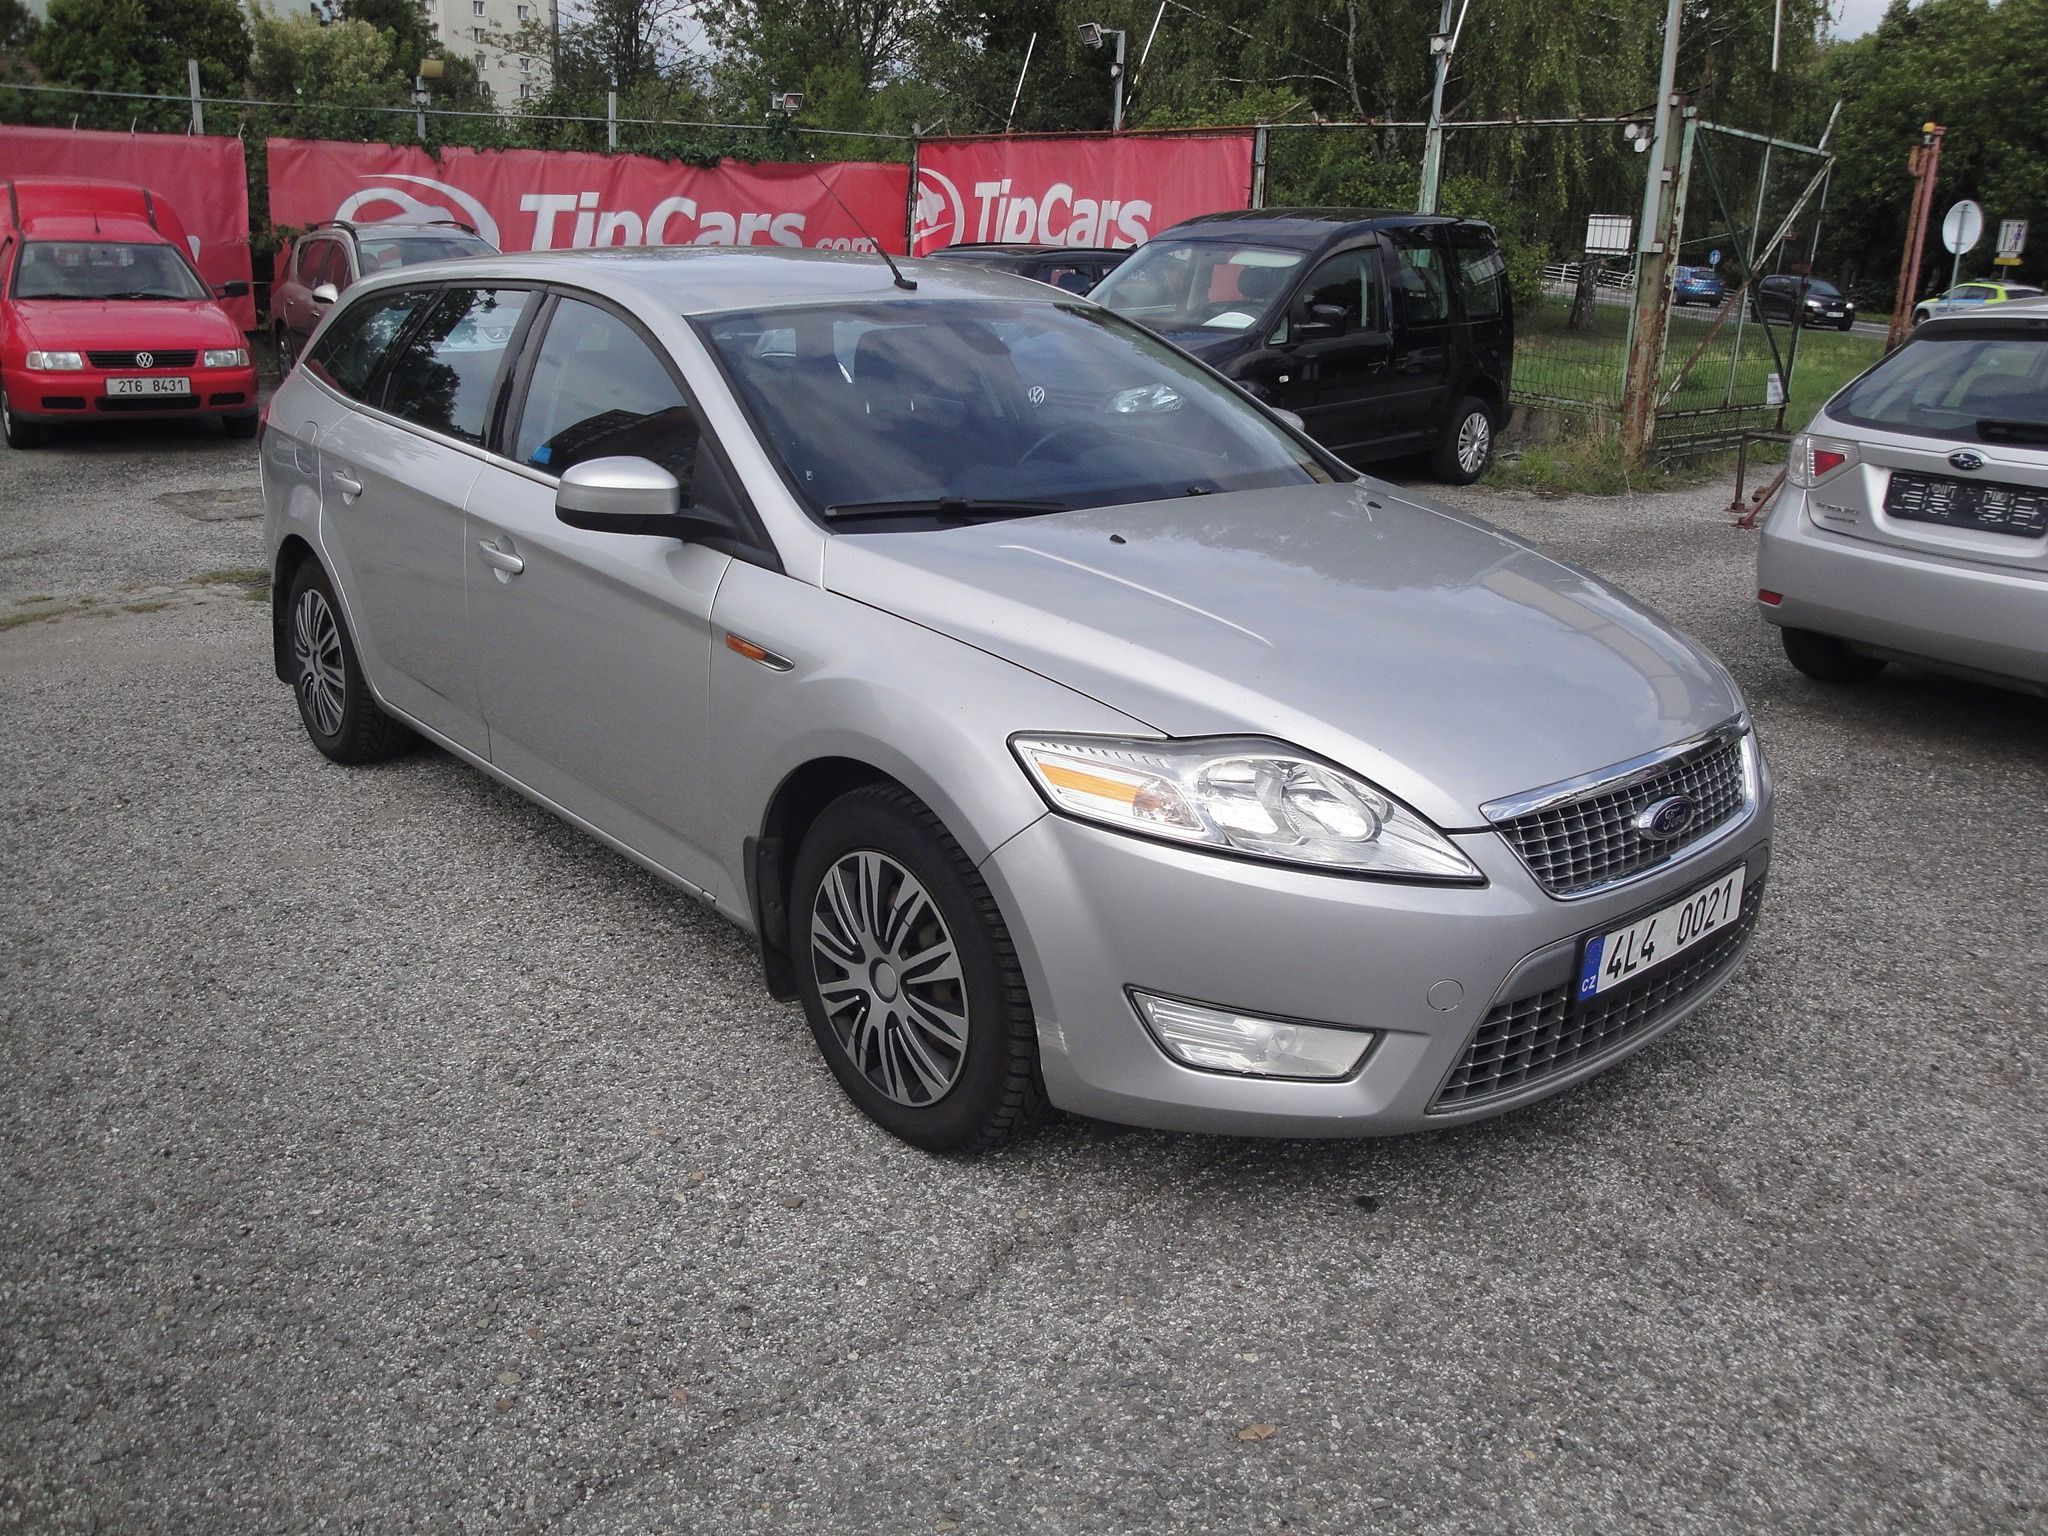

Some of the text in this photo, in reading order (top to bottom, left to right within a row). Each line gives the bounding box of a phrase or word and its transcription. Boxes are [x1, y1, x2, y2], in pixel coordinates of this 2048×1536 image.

[974, 178, 1152, 248] TipCars
[118, 379, 184, 393] 2T6 8431
[1663, 806, 1686, 831] Ford
[1605, 877, 1733, 979] 4L4 0021
[1581, 974, 1597, 993] CZ
